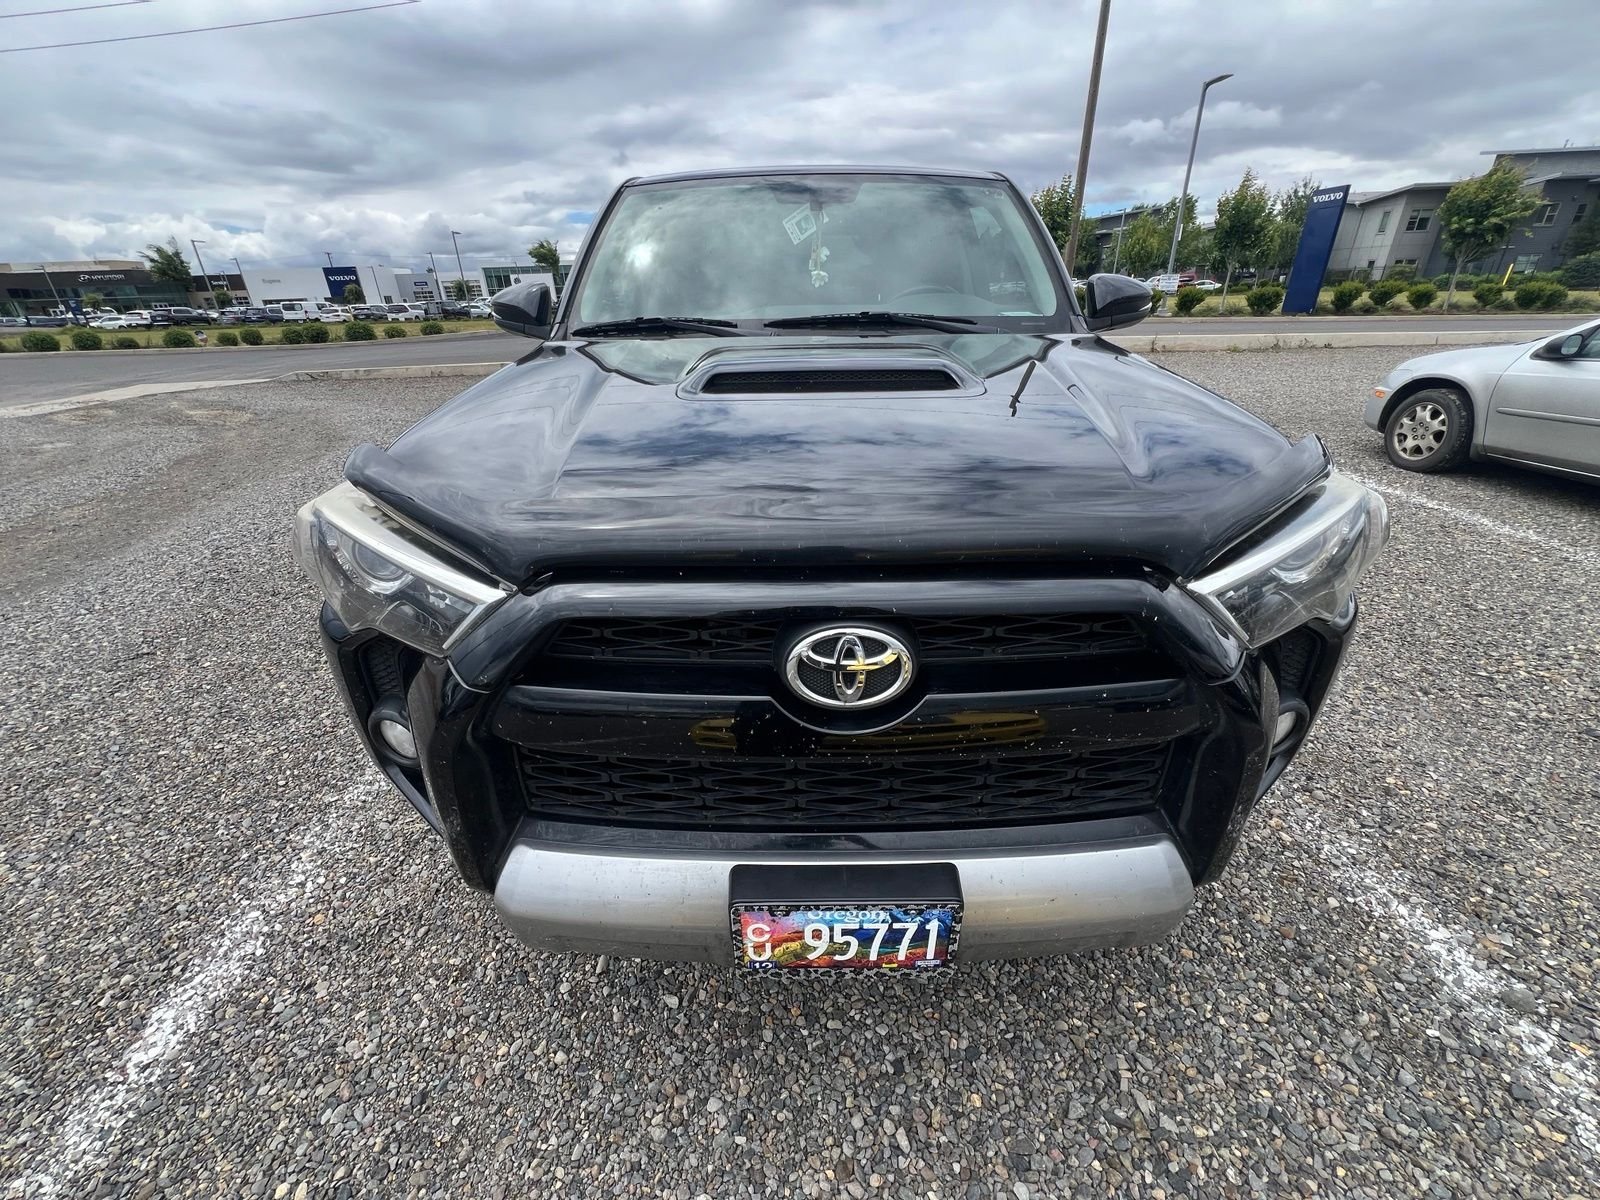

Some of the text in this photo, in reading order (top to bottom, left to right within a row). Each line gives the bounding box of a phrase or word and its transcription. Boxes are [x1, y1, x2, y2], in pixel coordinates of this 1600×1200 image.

[1312, 192, 1344, 203] VOLVO
[808, 910, 884, 923] Oregon
[804, 922, 939, 961] 95771
